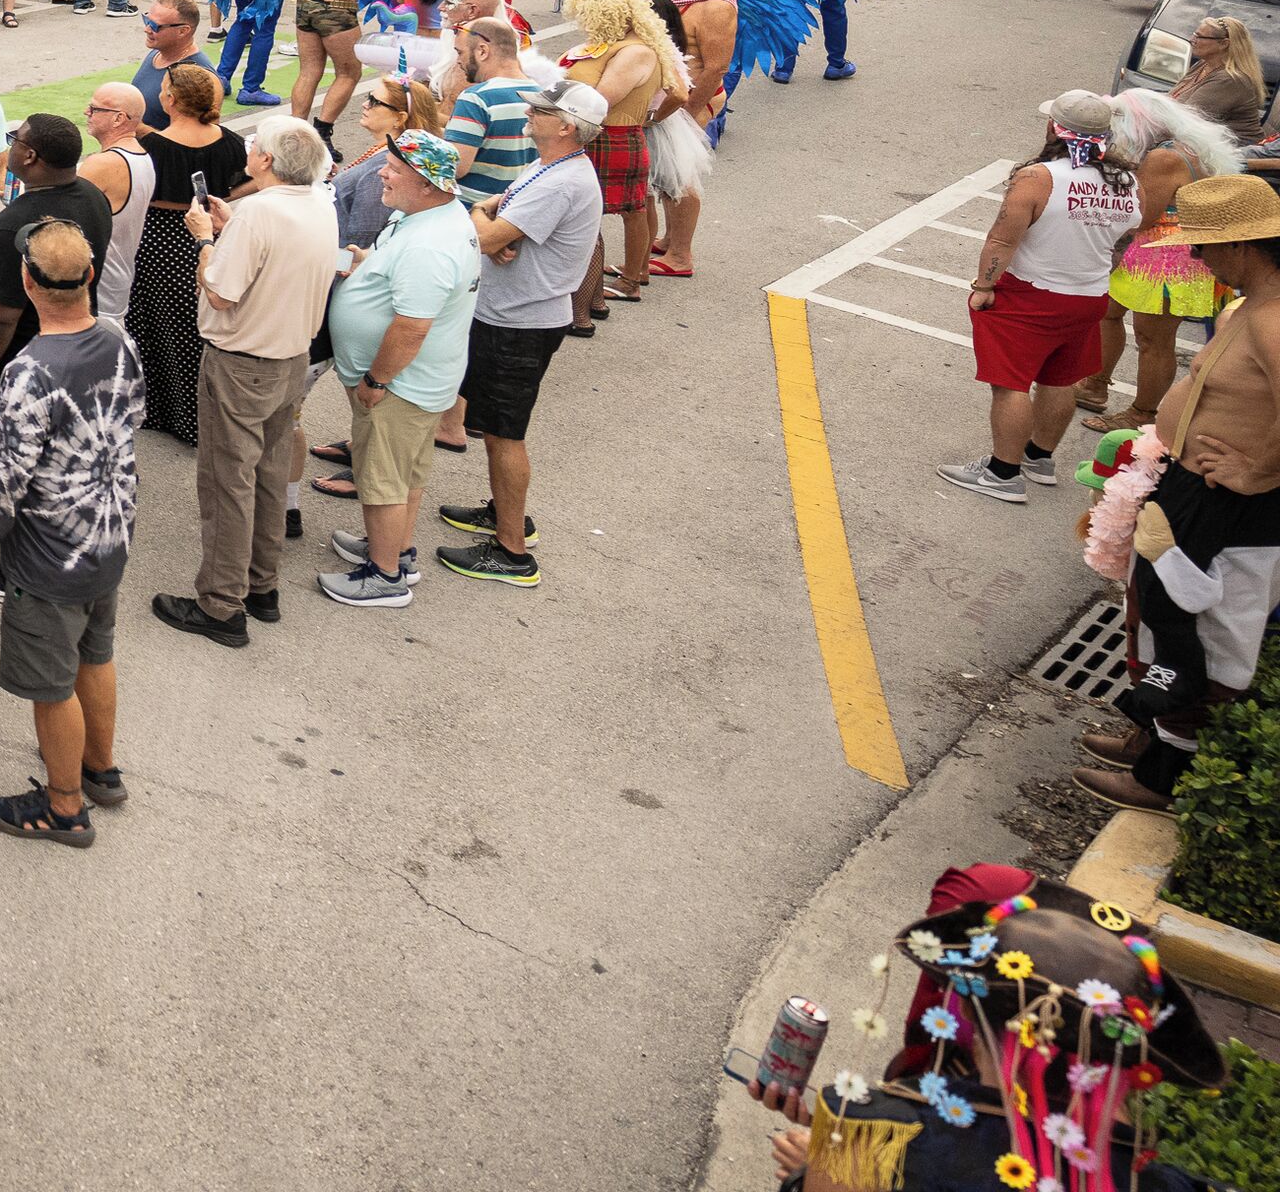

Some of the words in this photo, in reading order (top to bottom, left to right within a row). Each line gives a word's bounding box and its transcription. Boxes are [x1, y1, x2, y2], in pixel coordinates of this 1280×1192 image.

[1068, 181, 1098, 195] ANDY
[1101, 183, 1110, 196] &
[1067, 196, 1134, 213] DETAILING
